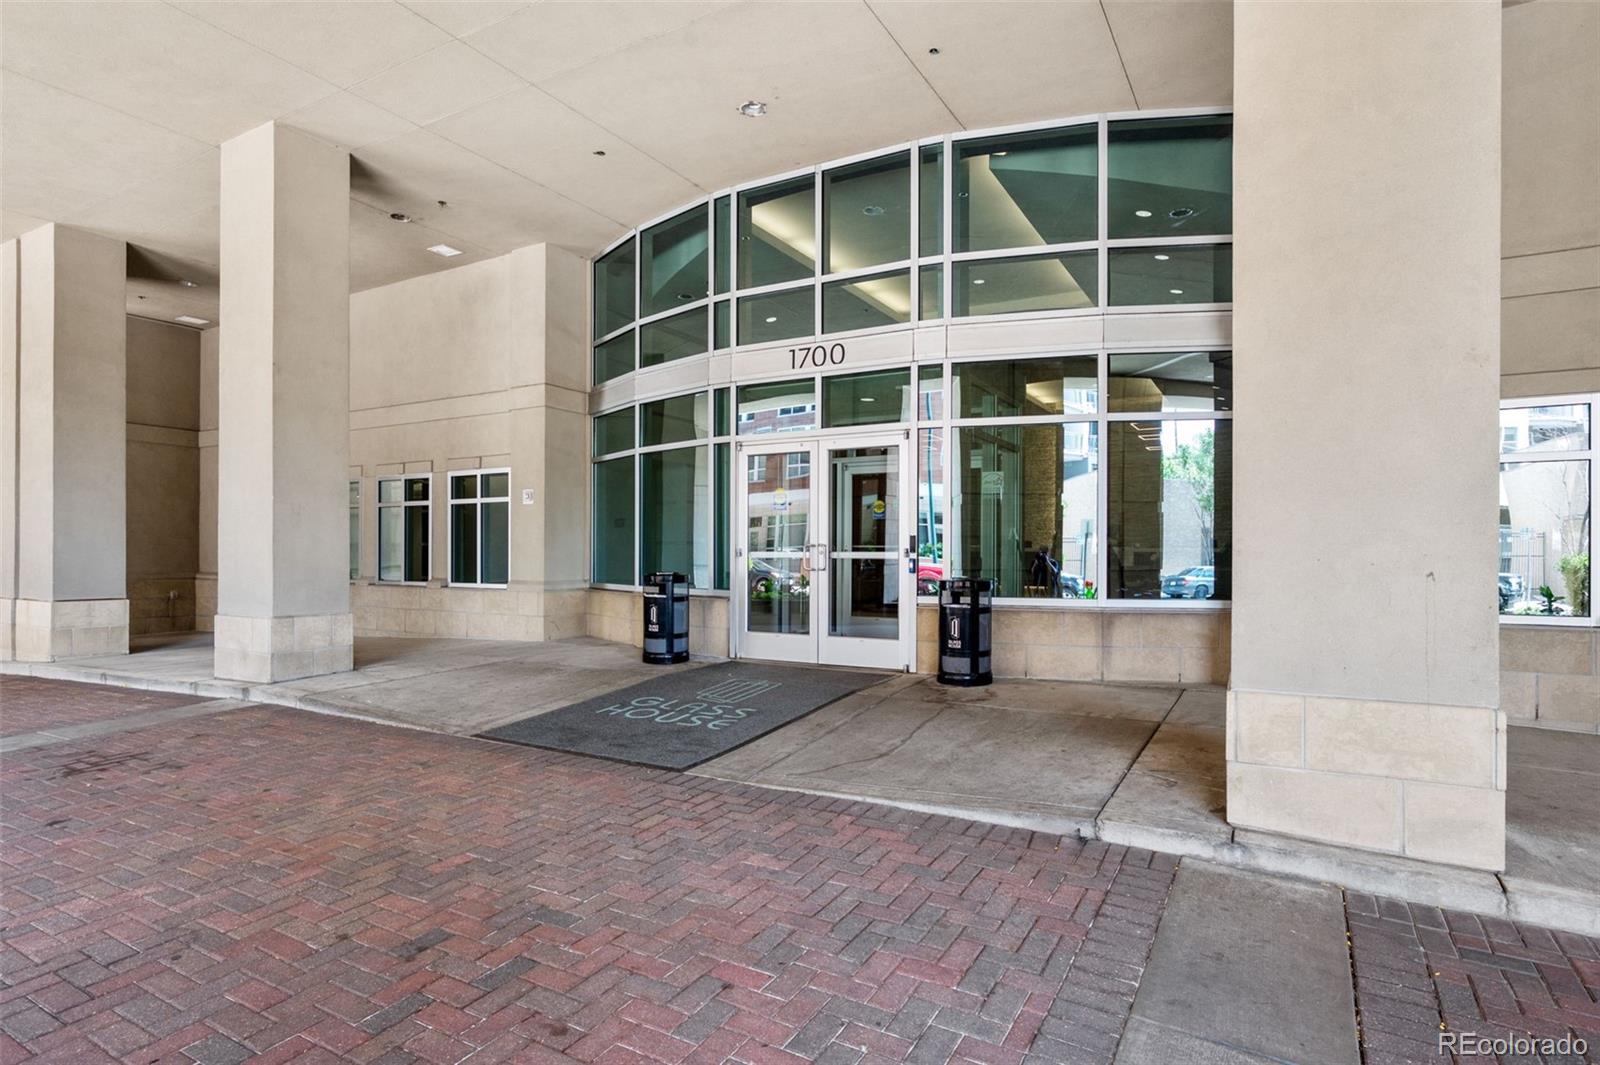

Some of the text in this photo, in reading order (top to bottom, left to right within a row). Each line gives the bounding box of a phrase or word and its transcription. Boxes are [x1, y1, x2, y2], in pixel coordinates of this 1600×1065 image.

[789, 343, 845, 369] 1700
[596, 704, 738, 730] HOUSE
[631, 696, 757, 719] GLASS
